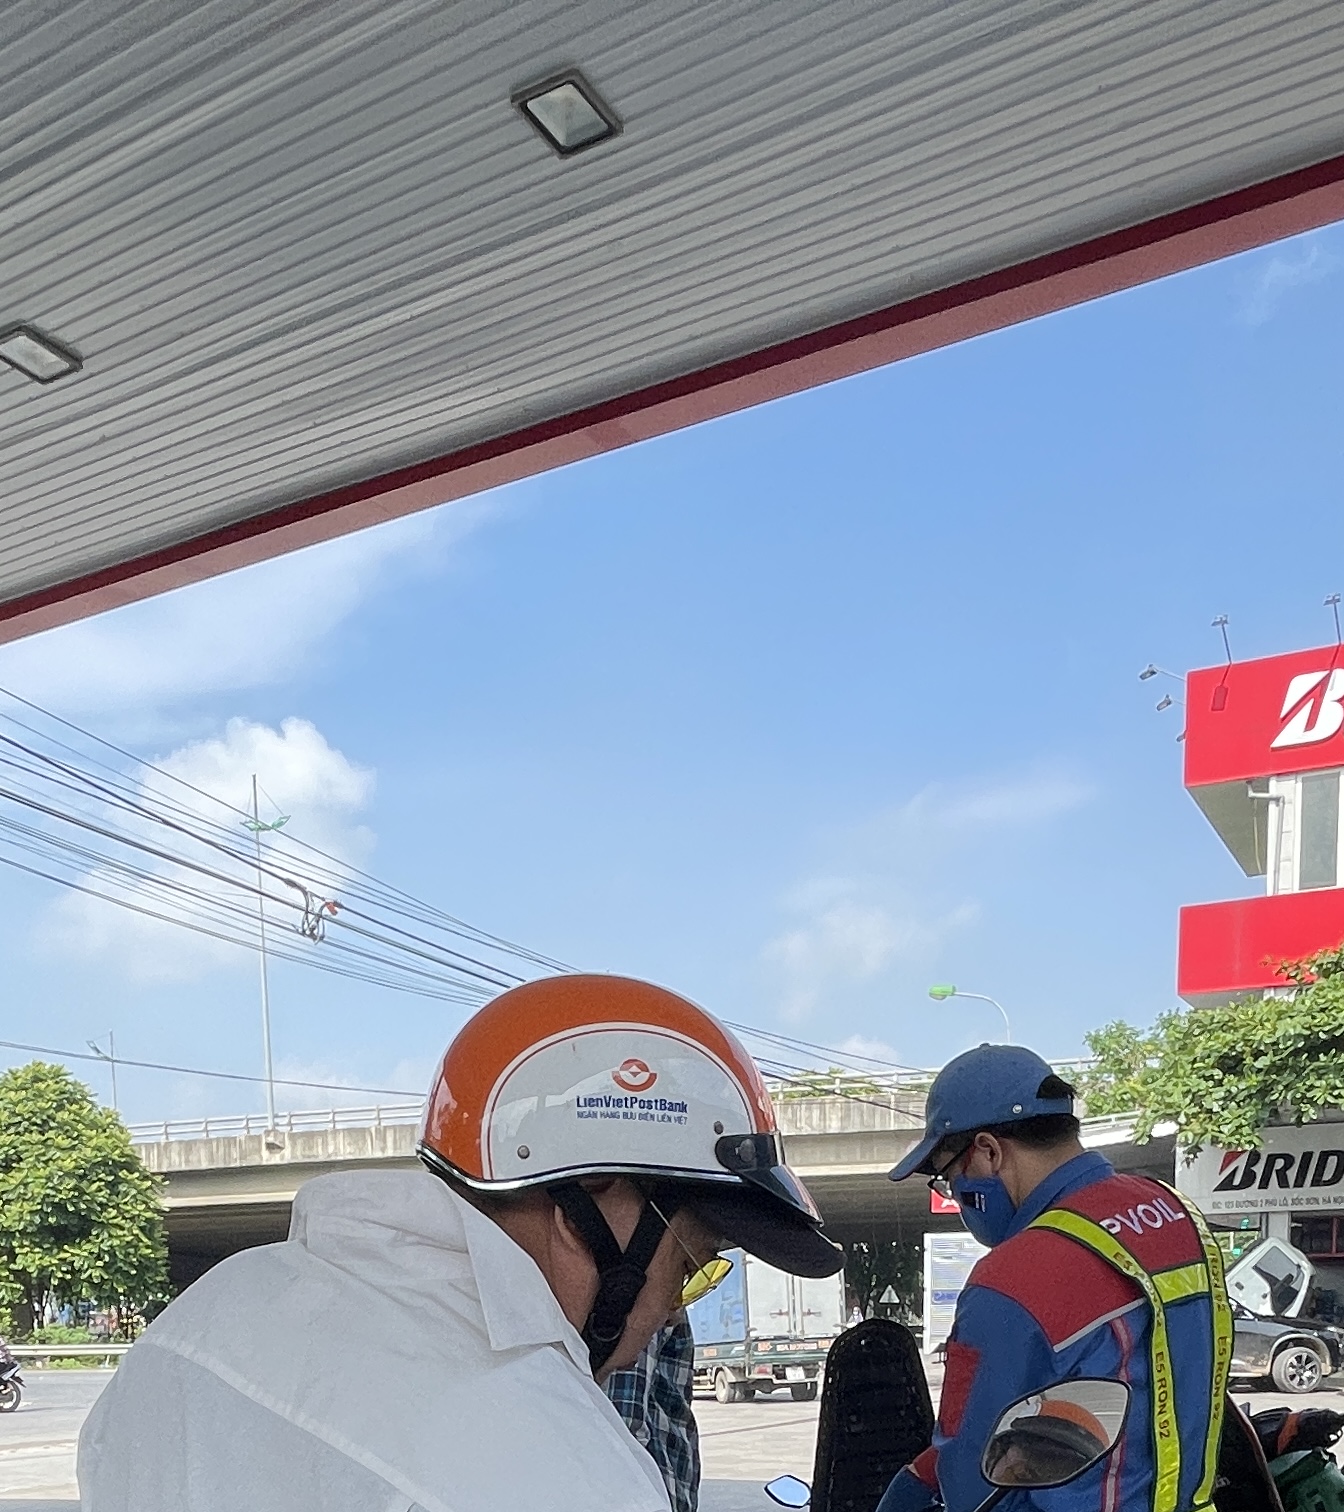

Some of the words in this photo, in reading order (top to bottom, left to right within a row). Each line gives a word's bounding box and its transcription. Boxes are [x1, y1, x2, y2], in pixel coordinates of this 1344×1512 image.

[1098, 1197, 1186, 1236] PVOIL
[1214, 1361, 1226, 1398] RON
[1156, 1381, 1169, 1416] RON
[1212, 1402, 1222, 1421] 92
[1158, 1419, 1171, 1440] 92
